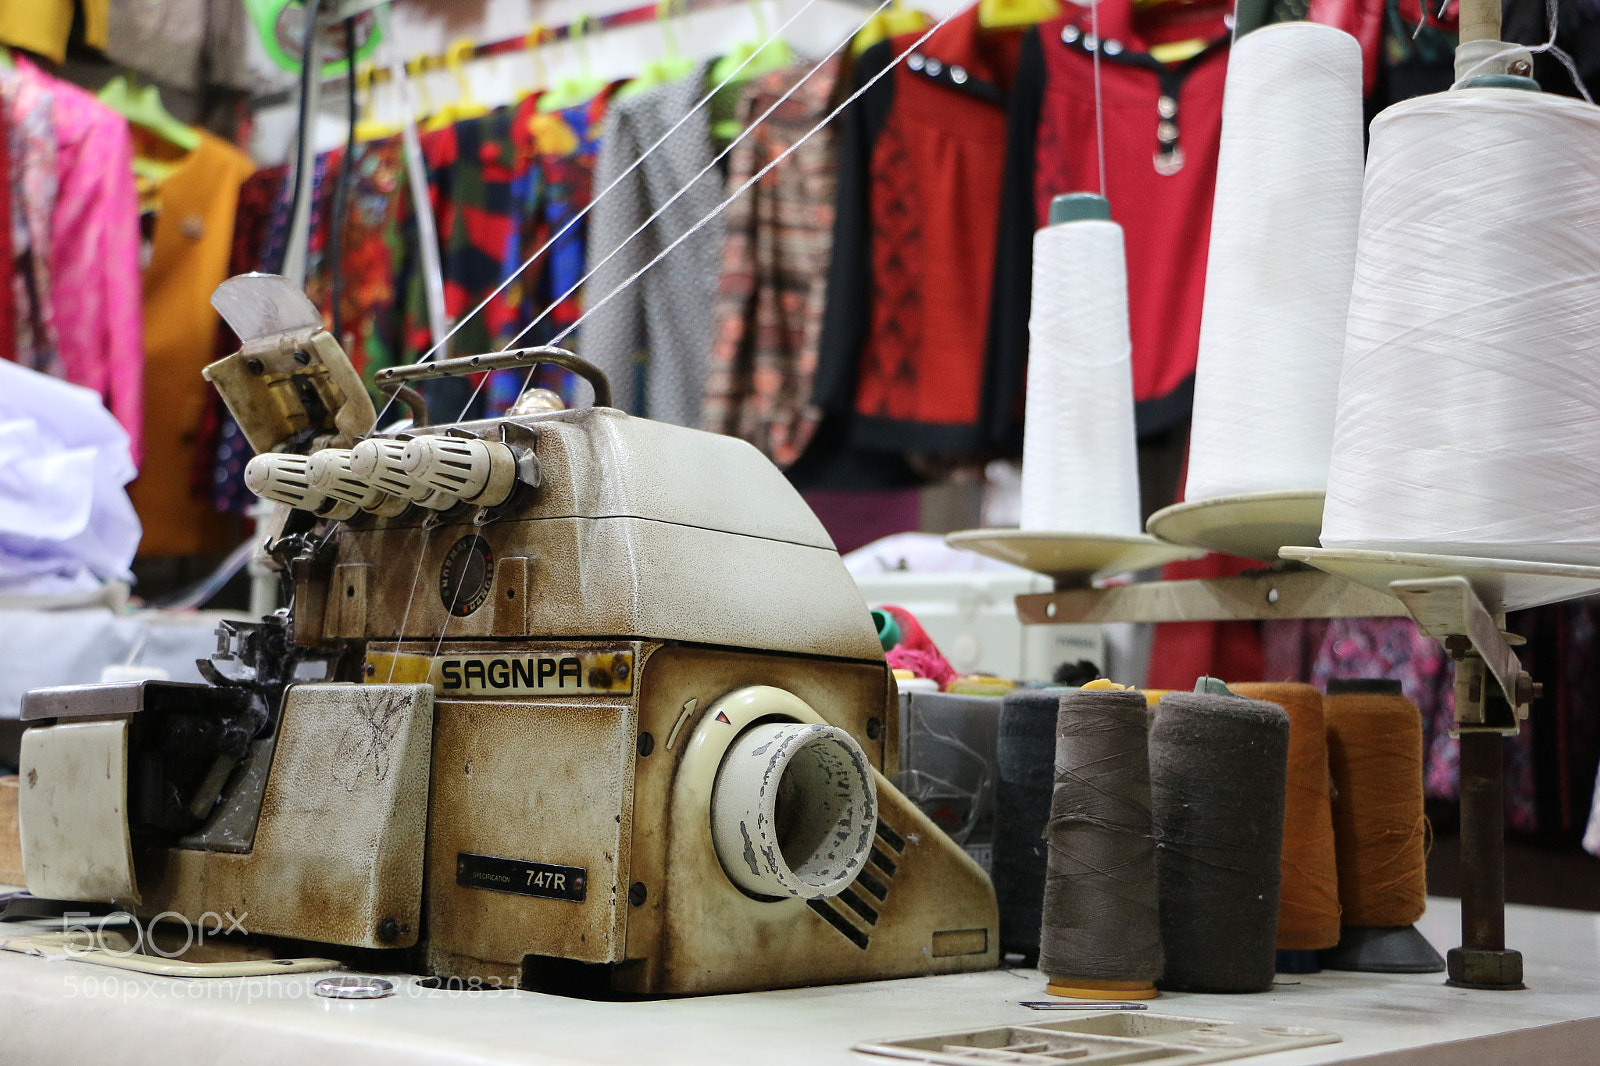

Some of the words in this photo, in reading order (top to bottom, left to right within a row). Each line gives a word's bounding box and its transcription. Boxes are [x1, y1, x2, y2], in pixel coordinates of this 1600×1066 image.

[441, 657, 582, 689] SAGNPA
[472, 871, 510, 883] SPECIFICATION
[526, 869, 566, 891] 747R
